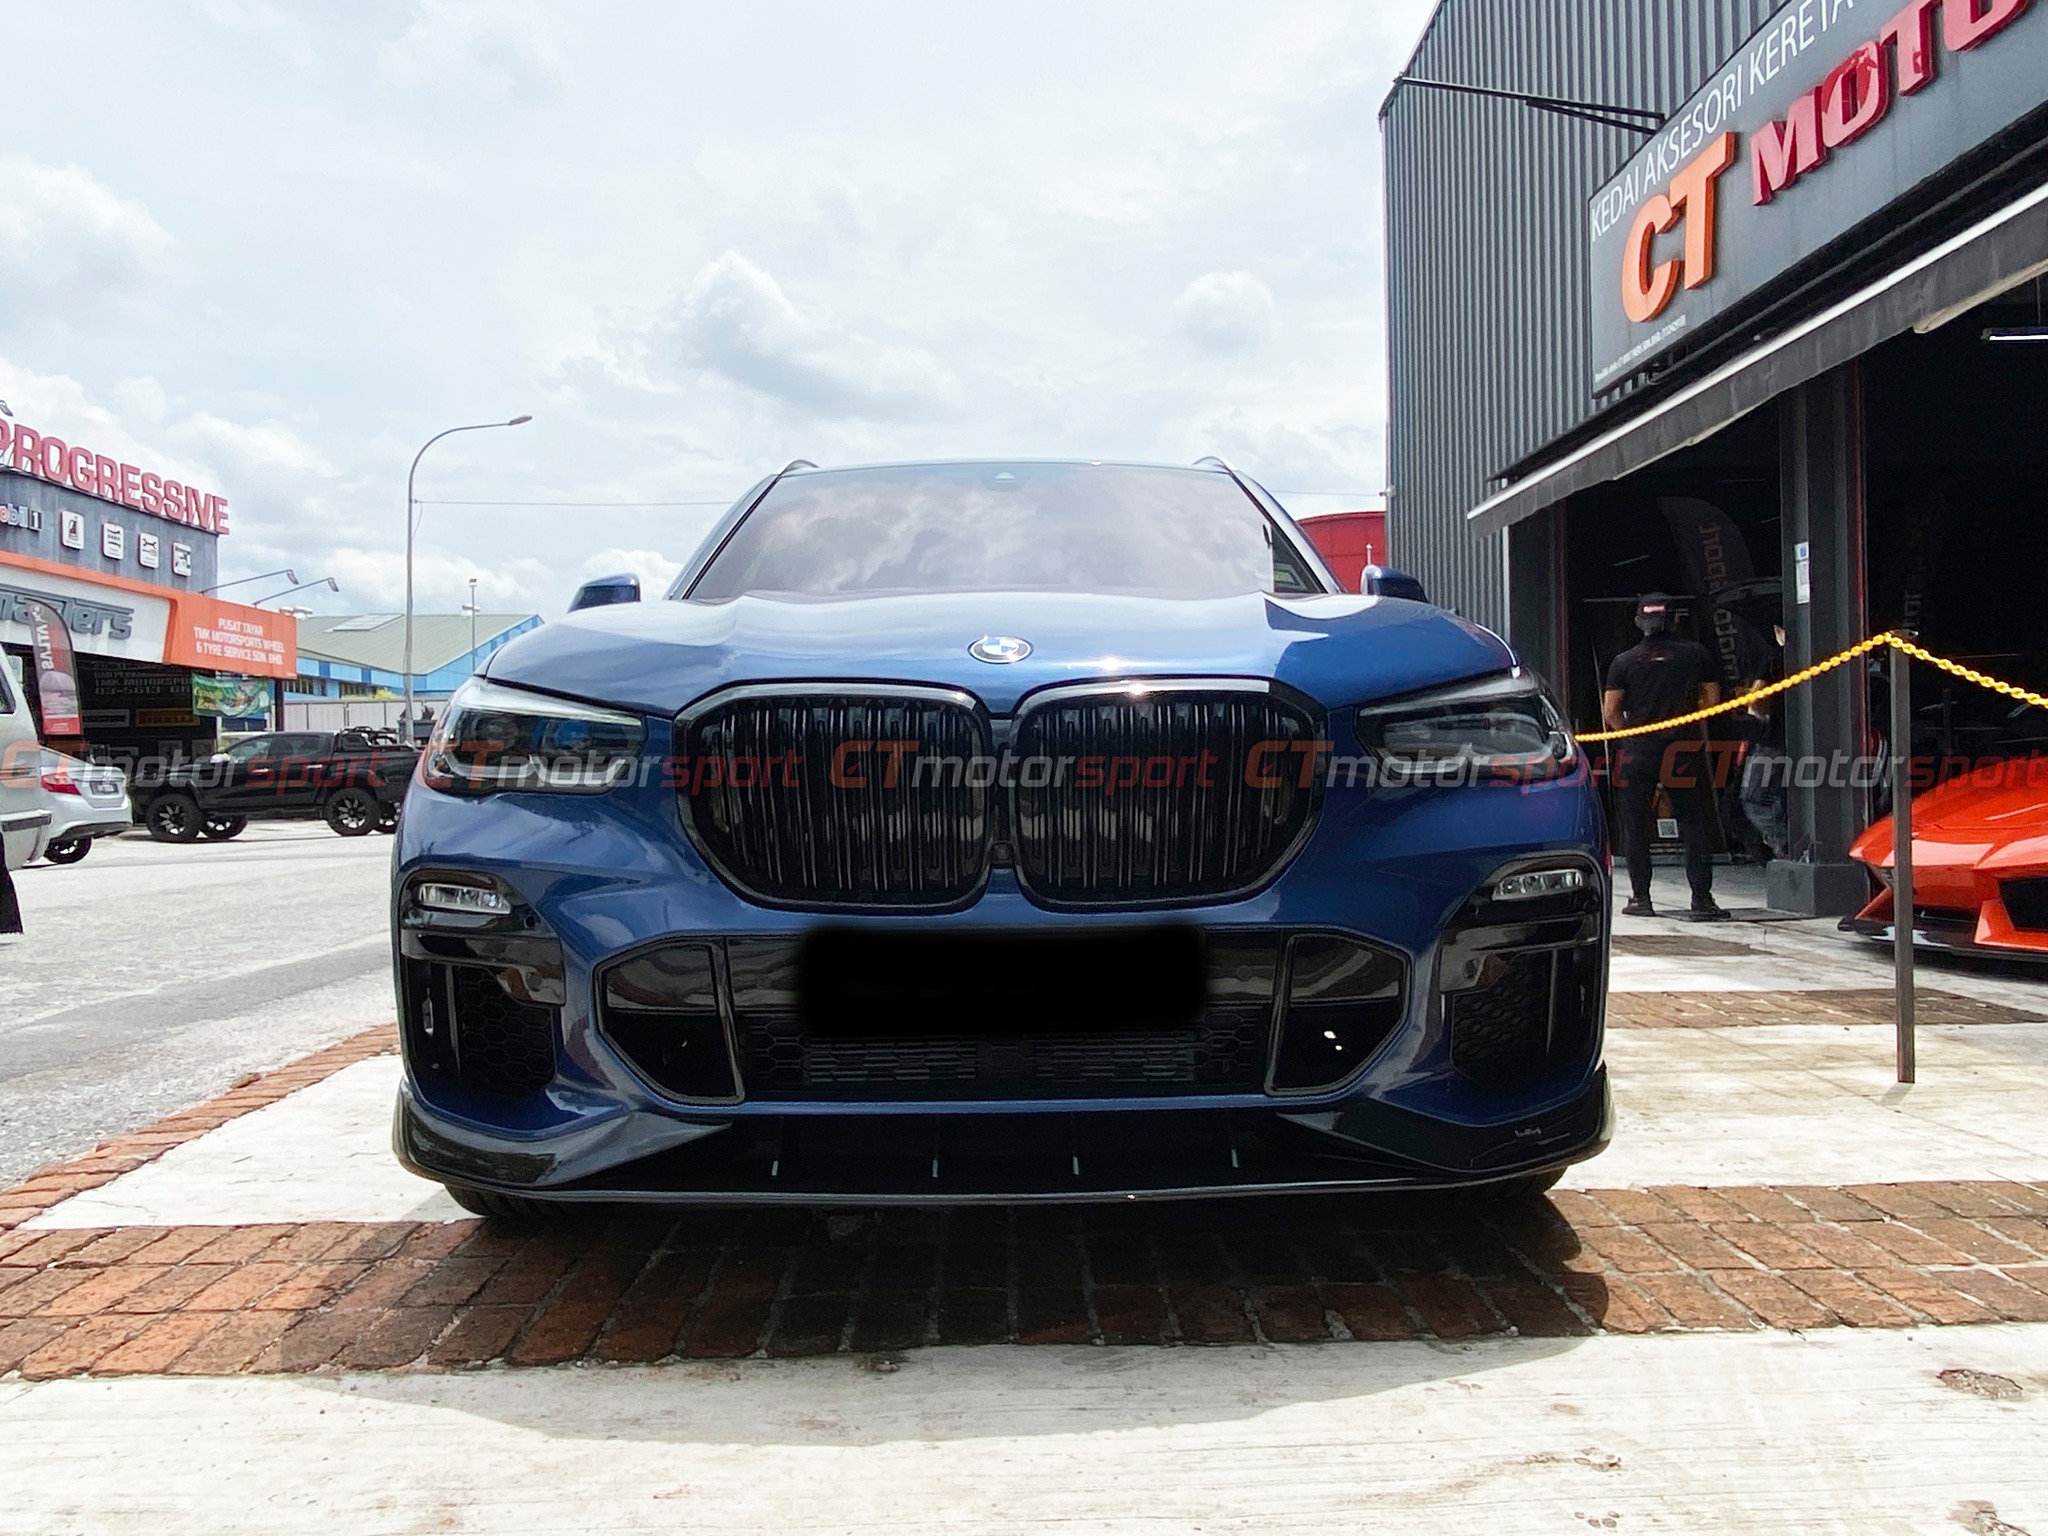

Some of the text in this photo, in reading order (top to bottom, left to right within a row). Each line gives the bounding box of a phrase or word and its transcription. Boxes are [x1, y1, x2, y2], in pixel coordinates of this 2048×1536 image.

[1590, 172, 1640, 242] KEDAI
[1643, 64, 1743, 194] AKSESORI
[1621, 131, 1736, 323] CT
[193, 626, 285, 653] TMK MOTORSPORTS WHEEL
[218, 617, 264, 637] PUSAT TAYAR
[203, 642, 223, 656] TYRE
[223, 645, 252, 660] SERVICE
